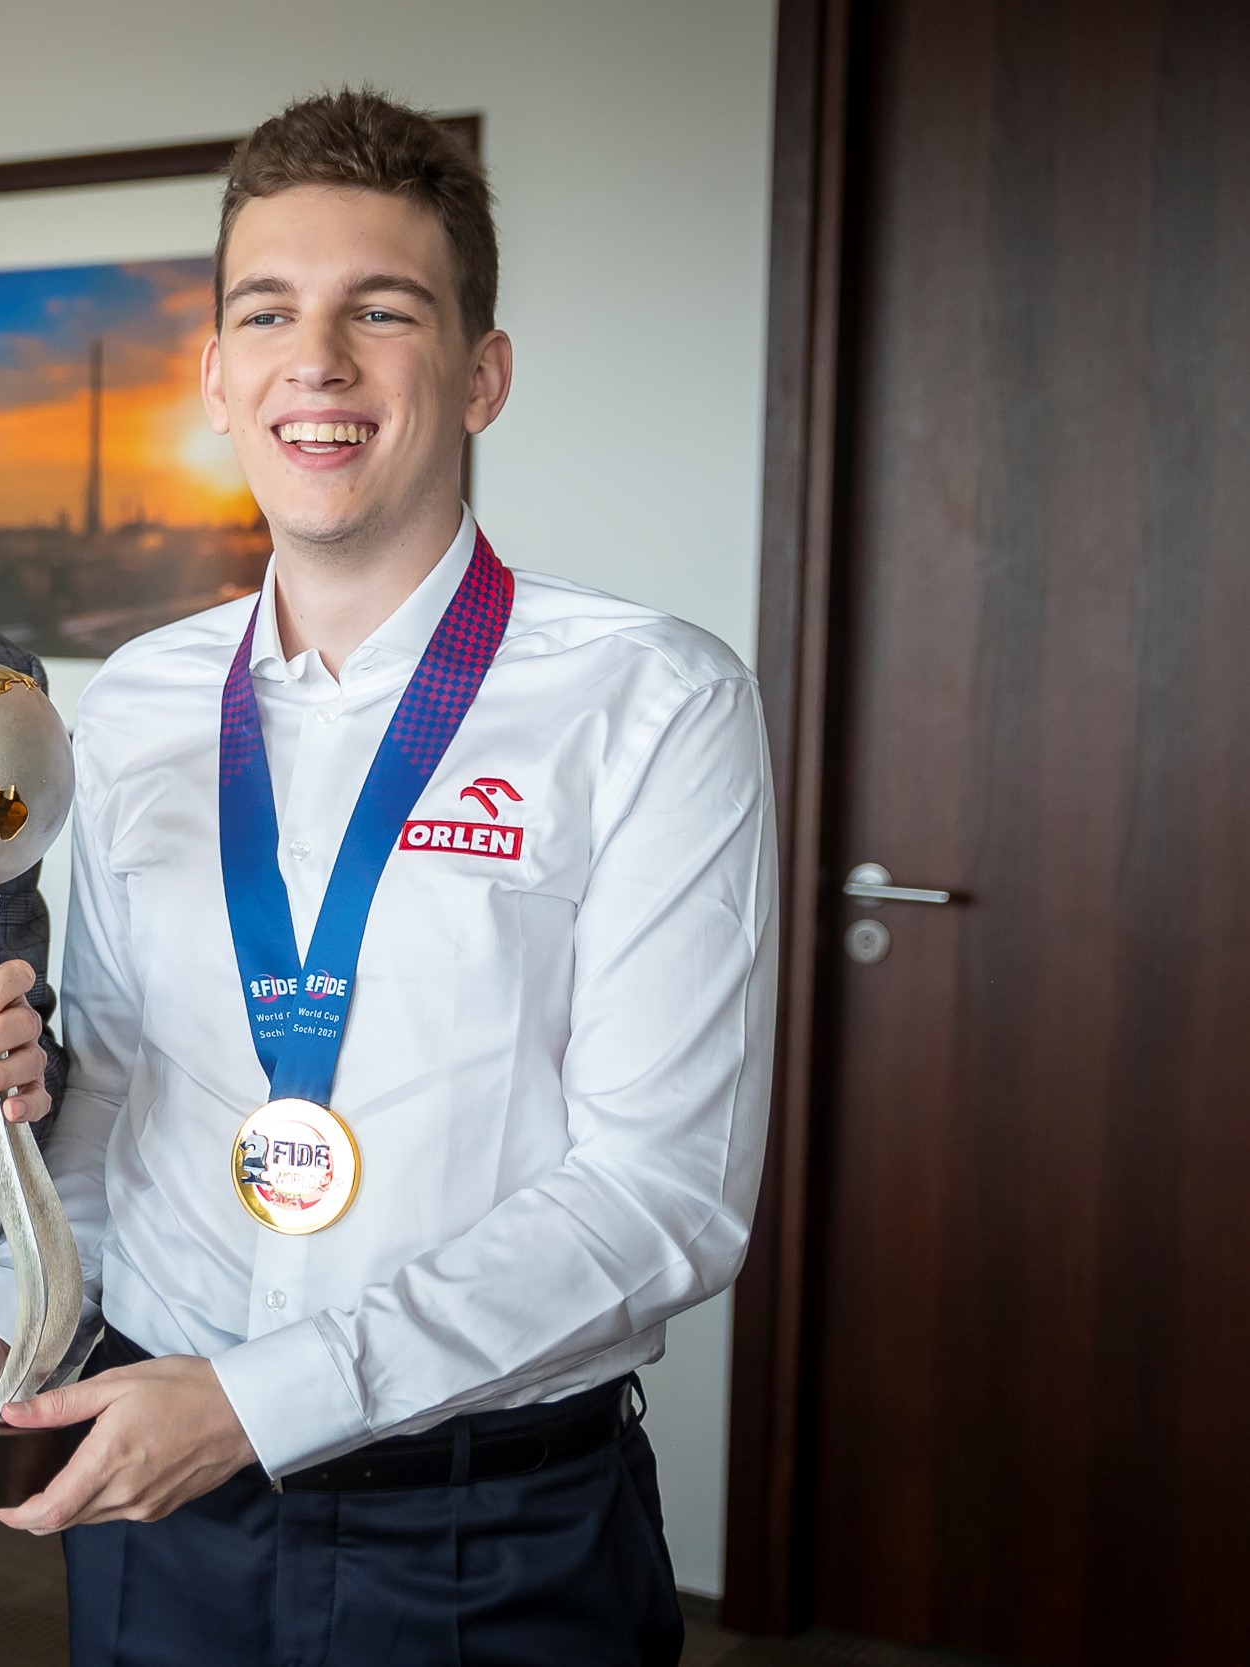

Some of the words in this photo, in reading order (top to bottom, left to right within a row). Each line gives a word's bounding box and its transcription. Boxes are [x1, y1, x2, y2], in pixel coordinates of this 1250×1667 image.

[407, 825, 515, 855] ORLEN
[260, 978, 298, 997] FIDE
[314, 976, 348, 997] FIDE
[256, 1012, 284, 1022] World
[298, 1007, 322, 1018] World
[324, 1012, 340, 1023] Cup
[259, 1028, 285, 1038] Sochi
[293, 1024, 316, 1034] Sochi
[318, 1029, 337, 1038] 2021
[273, 1140, 330, 1169] FIDE
